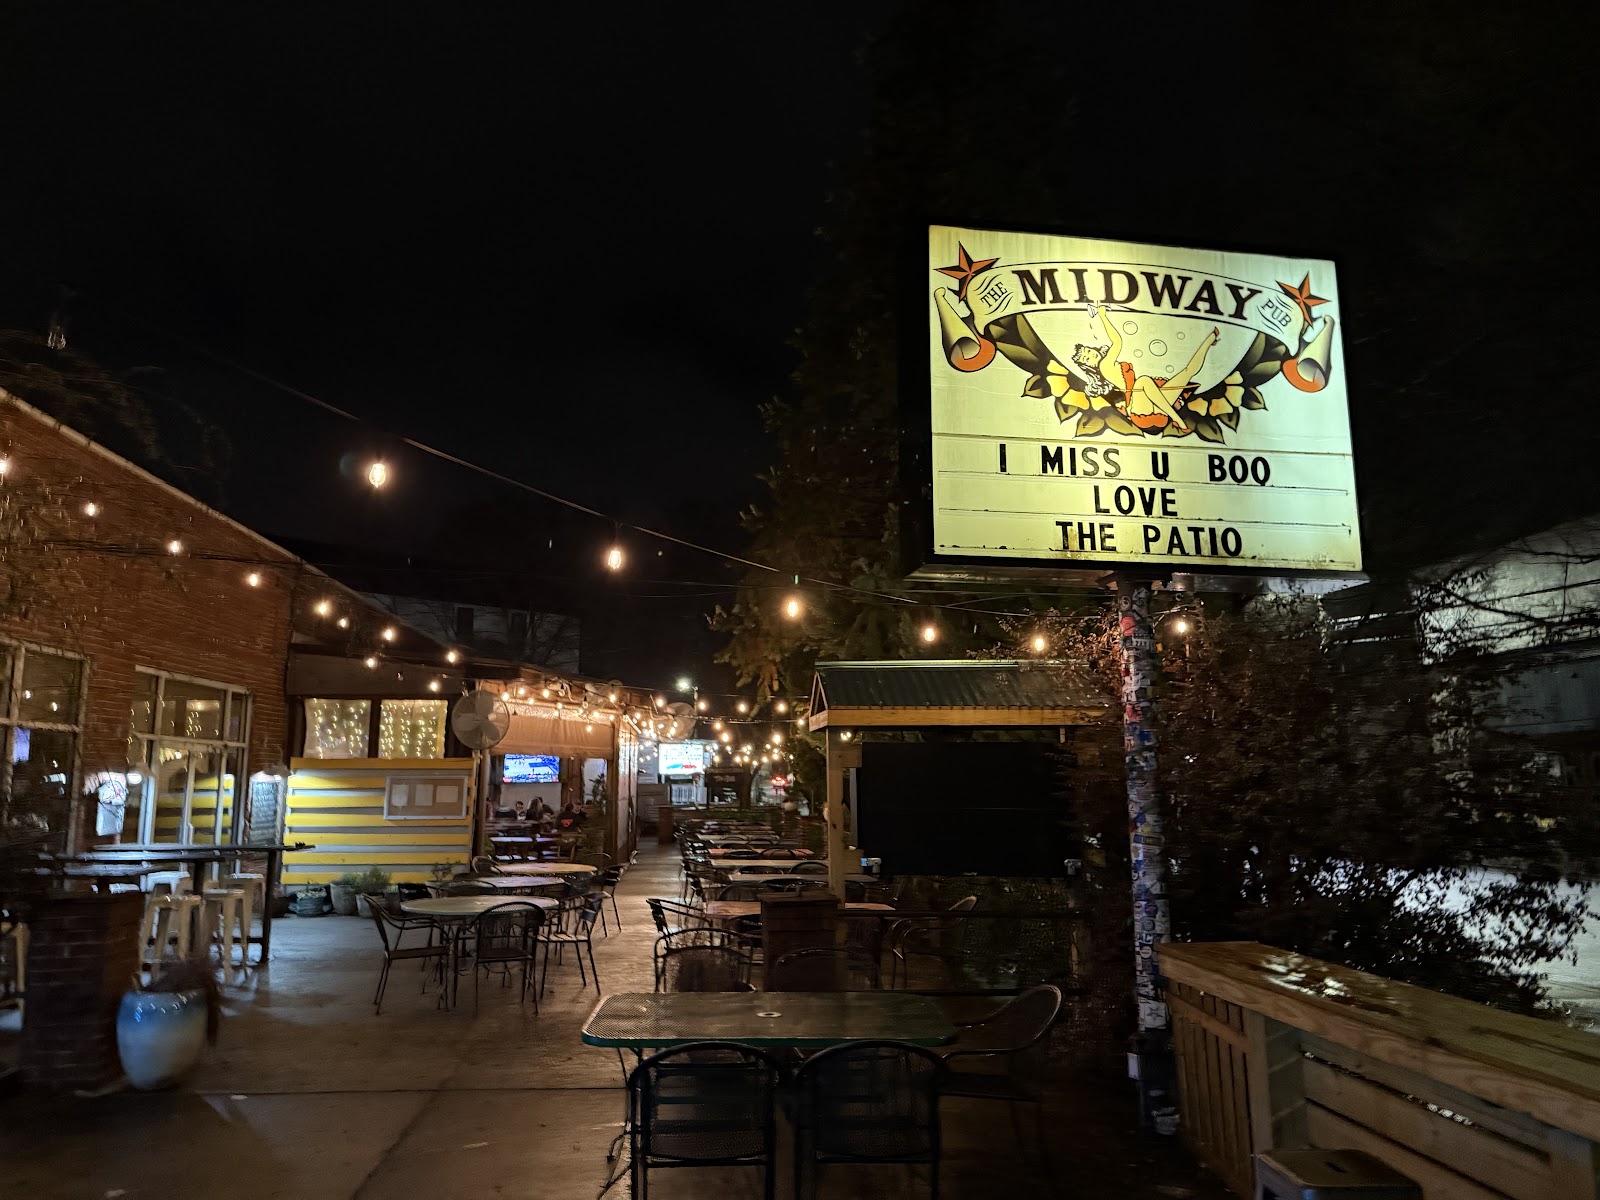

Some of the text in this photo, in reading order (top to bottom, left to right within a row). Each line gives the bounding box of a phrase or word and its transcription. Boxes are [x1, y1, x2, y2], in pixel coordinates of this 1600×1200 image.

[979, 267, 1293, 328] THE MIDWAY PUB
[999, 444, 1007, 473] I
[1041, 446, 1122, 477] MISS
[1151, 451, 1170, 481] U
[1094, 485, 1178, 517] LOVE
[1056, 521, 1244, 557] THE PATIO
